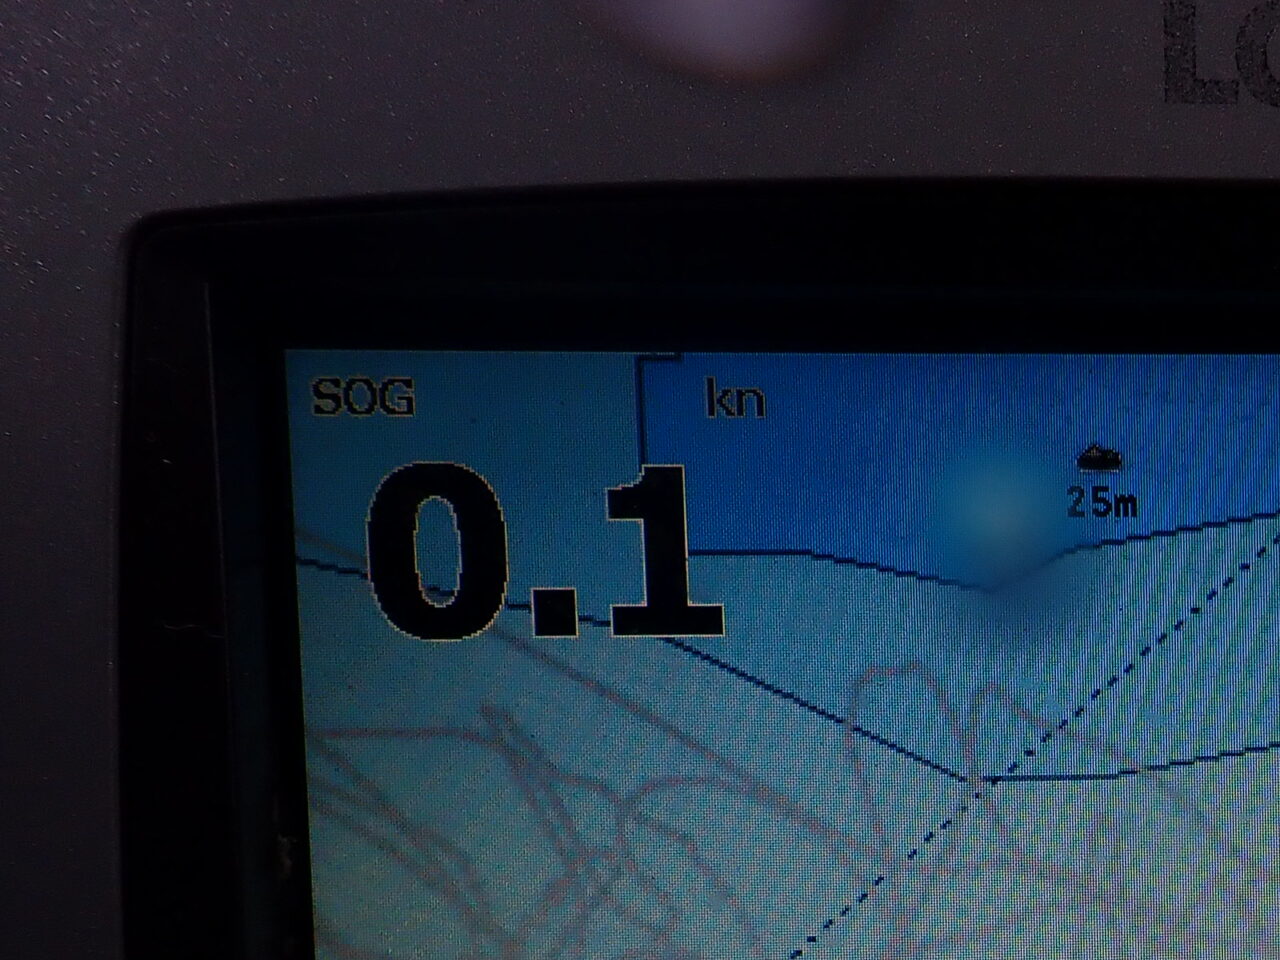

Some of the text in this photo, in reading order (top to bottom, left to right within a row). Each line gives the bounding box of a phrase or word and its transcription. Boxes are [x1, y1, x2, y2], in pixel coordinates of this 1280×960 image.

[312, 376, 416, 416] SOG
[704, 375, 766, 418] kn
[1067, 485, 1138, 518] 25m
[366, 461, 726, 642] 0.1
